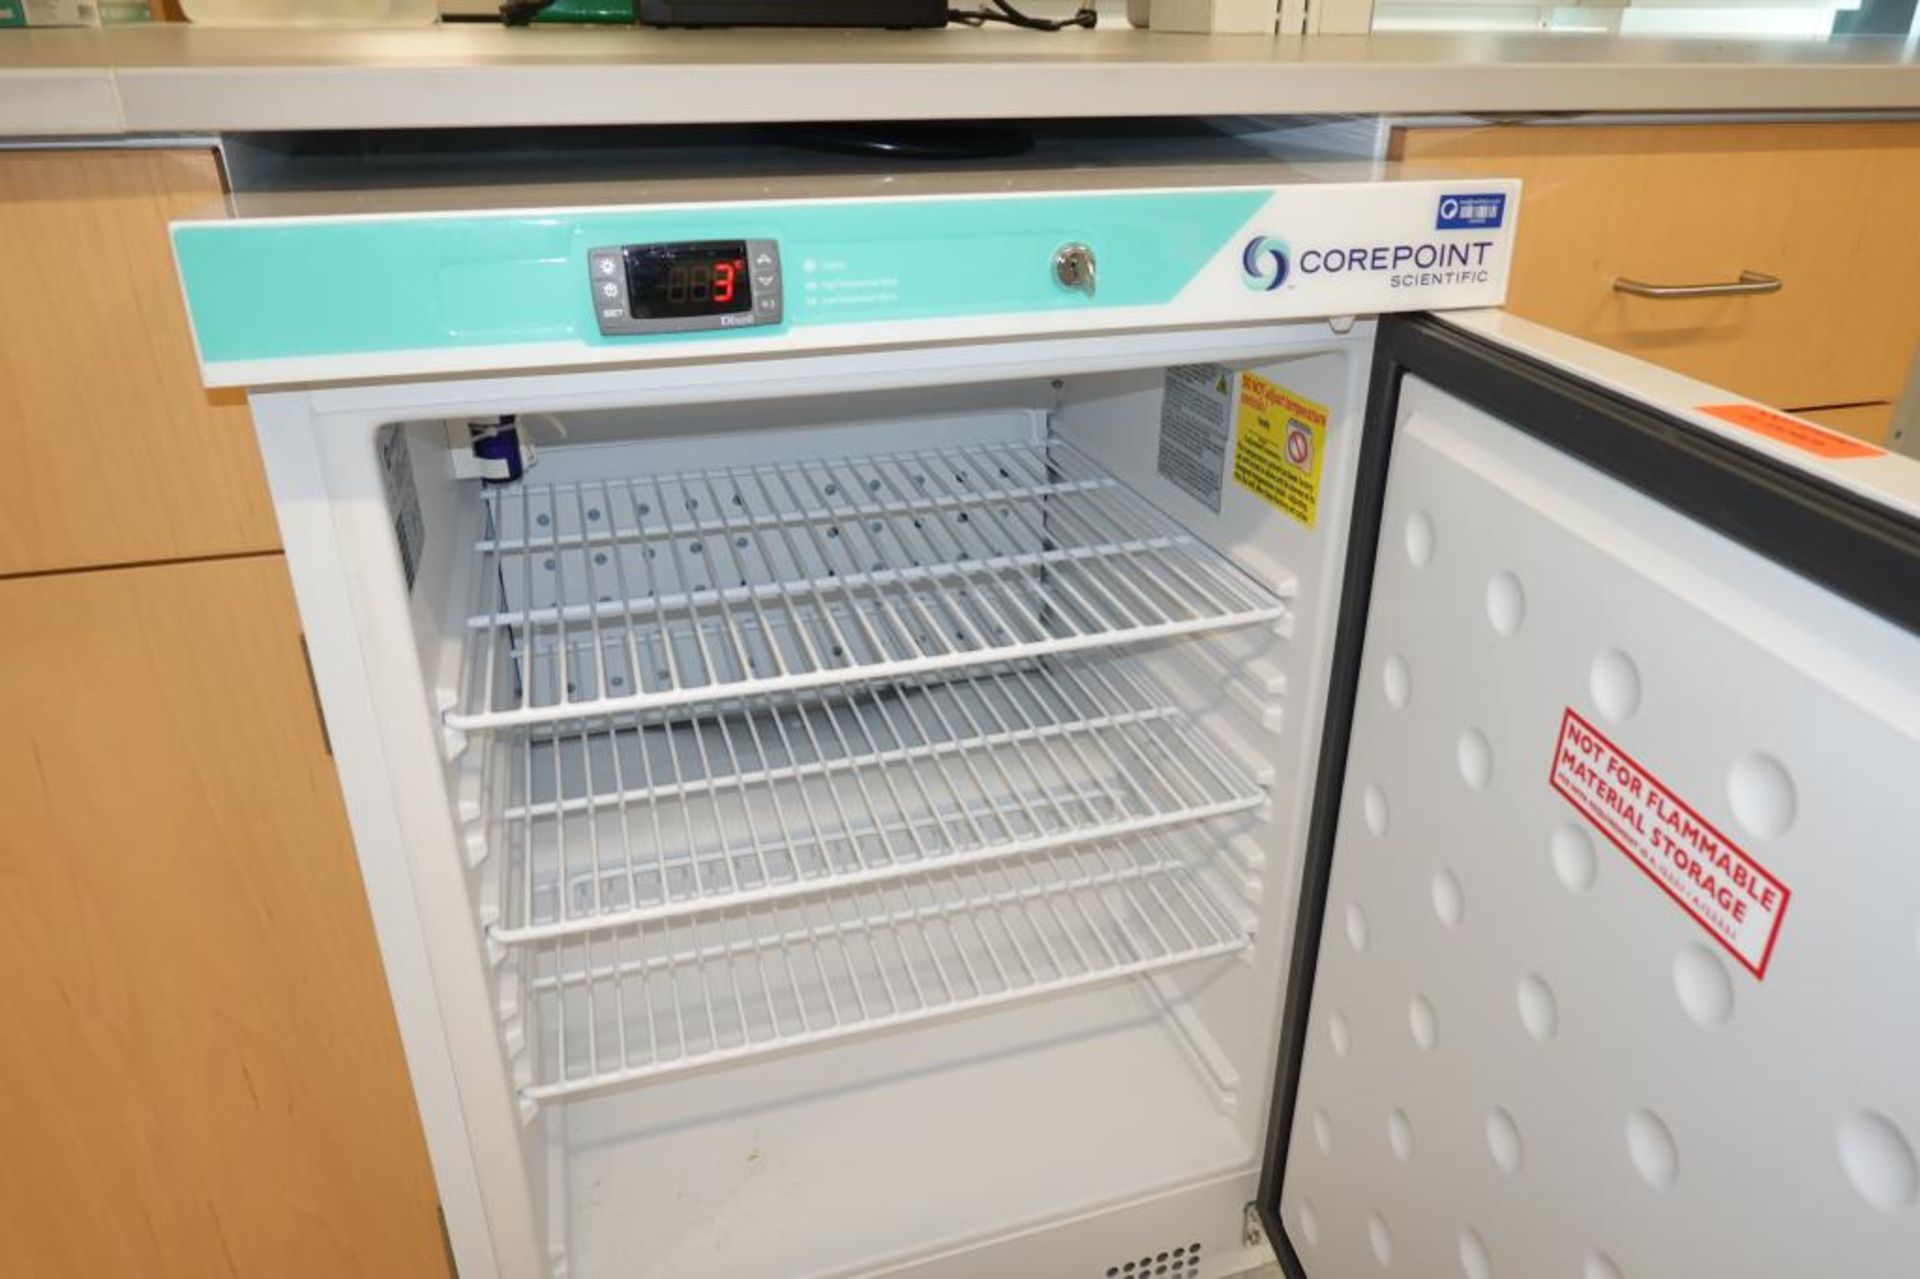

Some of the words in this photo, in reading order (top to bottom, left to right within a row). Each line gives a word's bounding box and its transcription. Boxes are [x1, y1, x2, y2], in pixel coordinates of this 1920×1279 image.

[1300, 241, 1493, 275] COREPOINT
[1390, 271, 1489, 288] SCIENTIFIC
[1560, 748, 1645, 836] MATERIAL
[1651, 827, 1748, 924] STORAGE
[1567, 723, 1605, 763] NOT
[1607, 756, 1643, 797] FOR
[1646, 792, 1776, 912] FLAMMABLE
